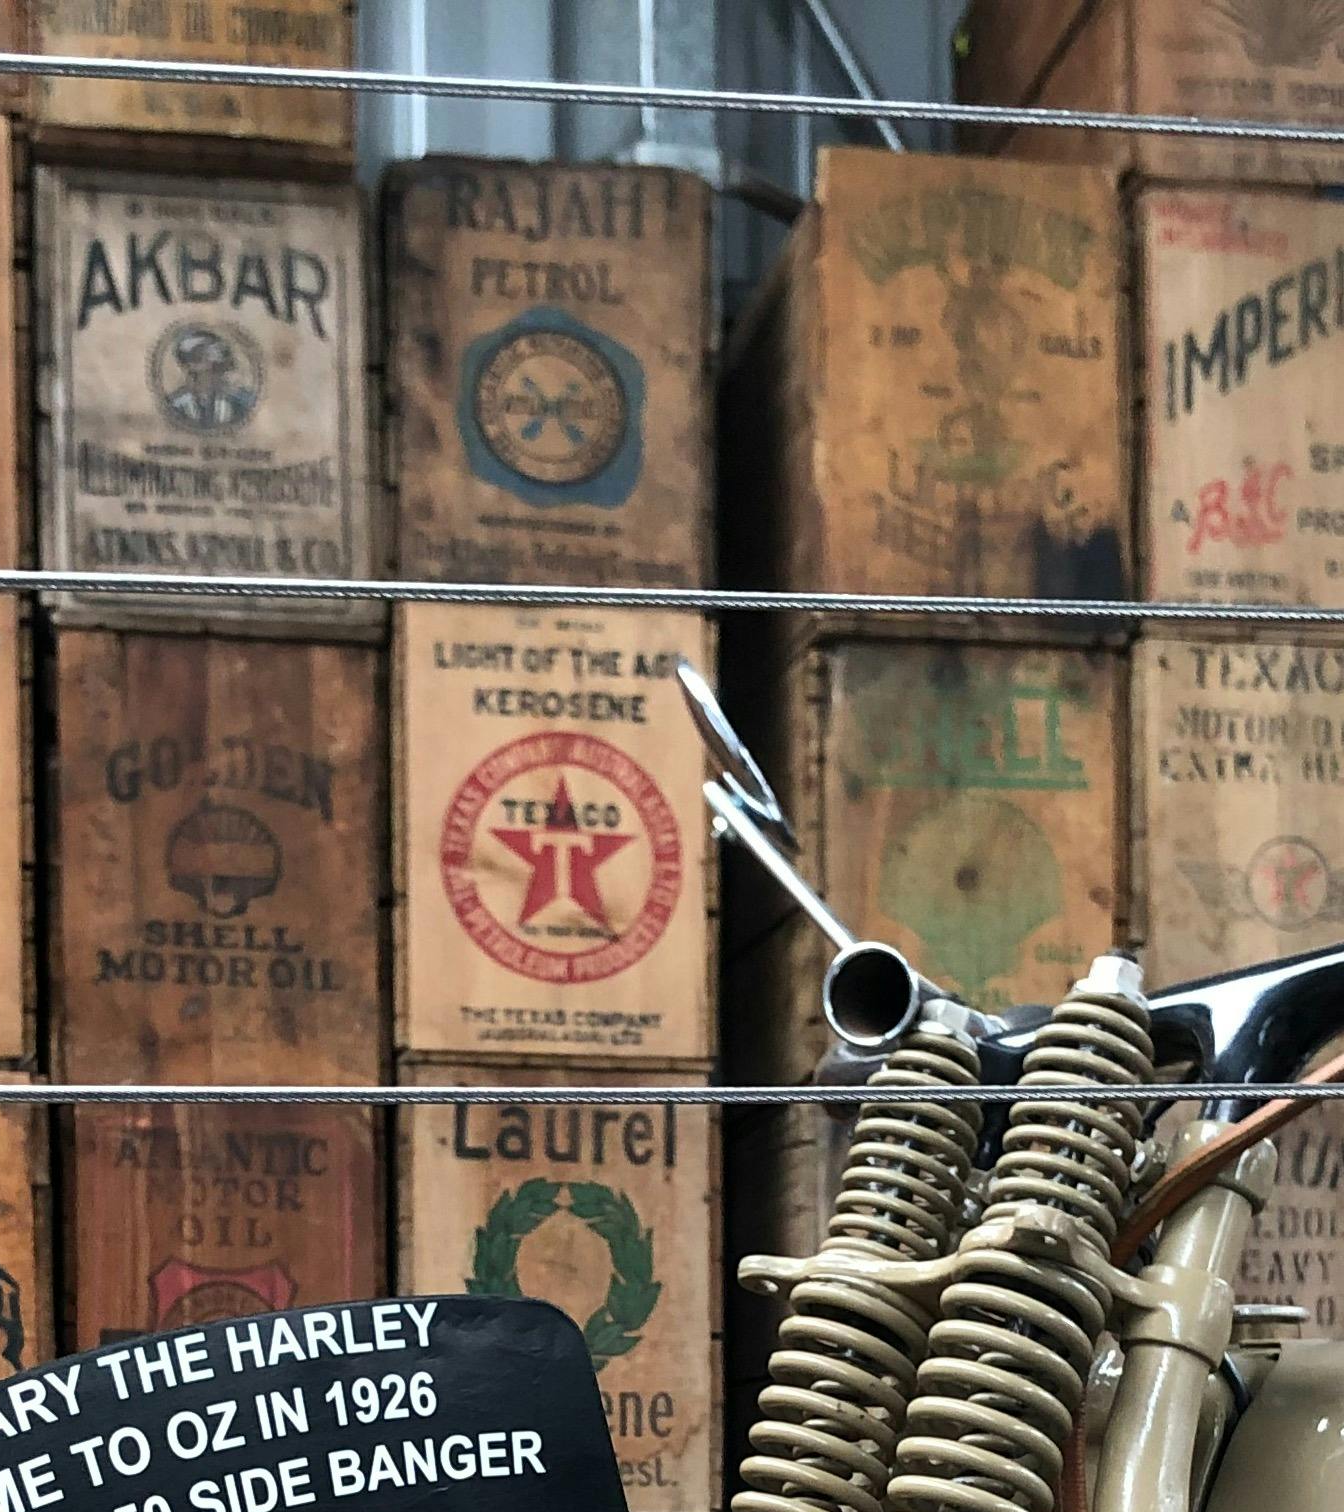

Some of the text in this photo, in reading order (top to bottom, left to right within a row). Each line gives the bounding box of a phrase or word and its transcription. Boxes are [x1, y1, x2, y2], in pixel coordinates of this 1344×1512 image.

[444, 172, 644, 242] RAJAH
[76, 229, 331, 341] AKBAR
[470, 255, 627, 303] PETROL
[432, 638, 624, 678] LIGHT OF THE
[473, 689, 649, 725] KEROSENE
[501, 799, 623, 829] TEXACO
[139, 917, 305, 952] SHELL
[93, 947, 347, 993] MOTOR OIL
[110, 1128, 330, 1178] ATLANTIC
[454, 1100, 679, 1168] Laurel
[156, 1177, 304, 1211] MOTOR
[171, 1214, 274, 1248] OIL
[96, 1329, 215, 1402] THE
[226, 1301, 439, 1374] HARLEY
[70, 1425, 153, 1488] TO
[165, 1400, 246, 1461] OZ
[255, 1385, 311, 1441] IN
[322, 1370, 439, 1428] 1926
[328, 1430, 548, 1494] BANGER
